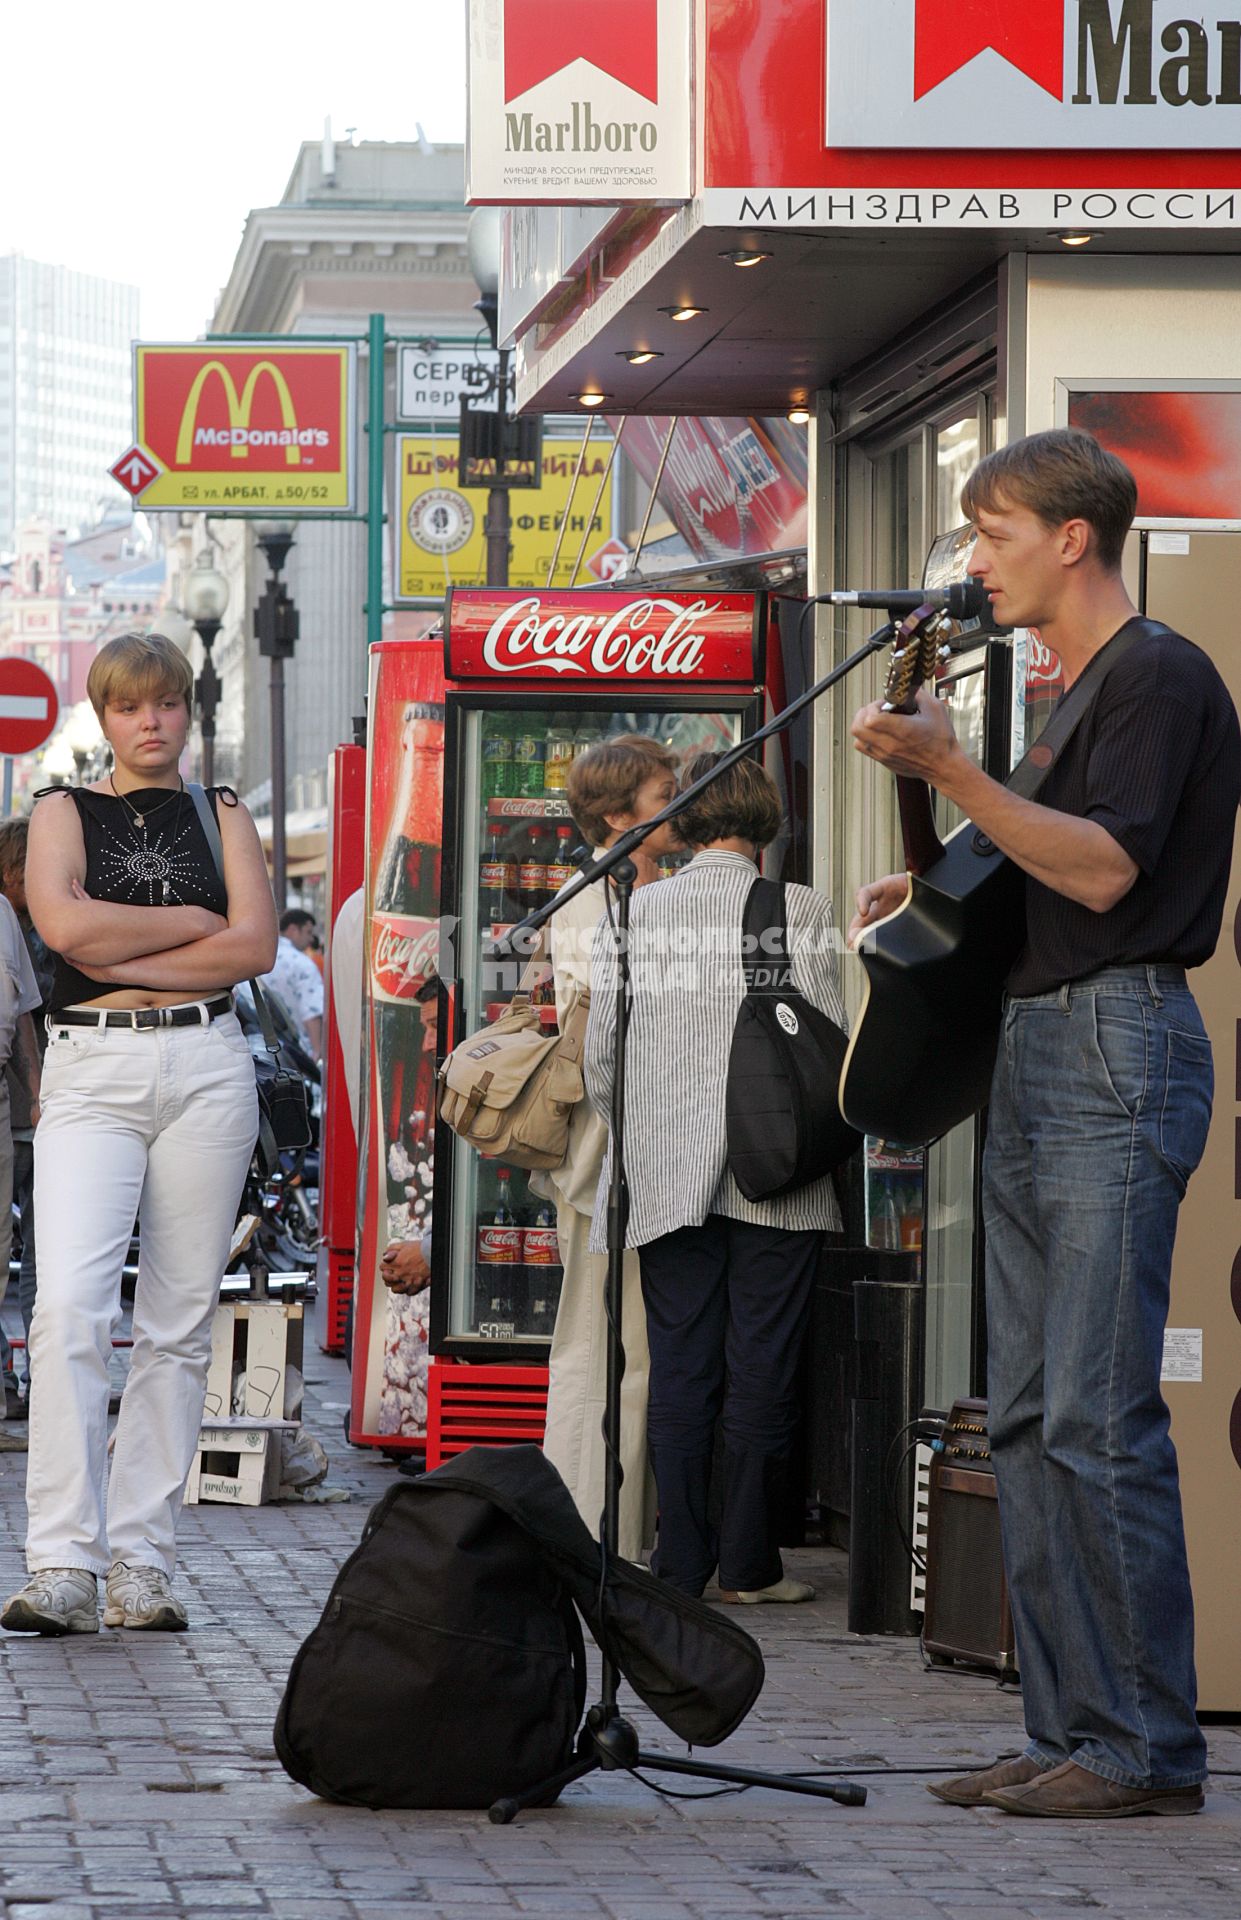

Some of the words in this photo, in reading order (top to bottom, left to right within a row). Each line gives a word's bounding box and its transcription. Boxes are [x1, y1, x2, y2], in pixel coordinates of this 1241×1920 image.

[504, 102, 658, 152] Marlboro
[503, 177, 538, 185] КУРЕНИЕ
[542, 177, 571, 186] ВРЕДИТ
[574, 177, 608, 185] ВАШЕМУ
[611, 177, 658, 186] ЗДОРОВЬЮ
[504, 166, 548, 176] МИНЗДРАВ
[550, 166, 587, 175] РОССИИ
[738, 194, 1021, 223] МИНЗДРАВ
[195, 427, 330, 446] McDonald's
[482, 597, 722, 674] Coca-Cola
